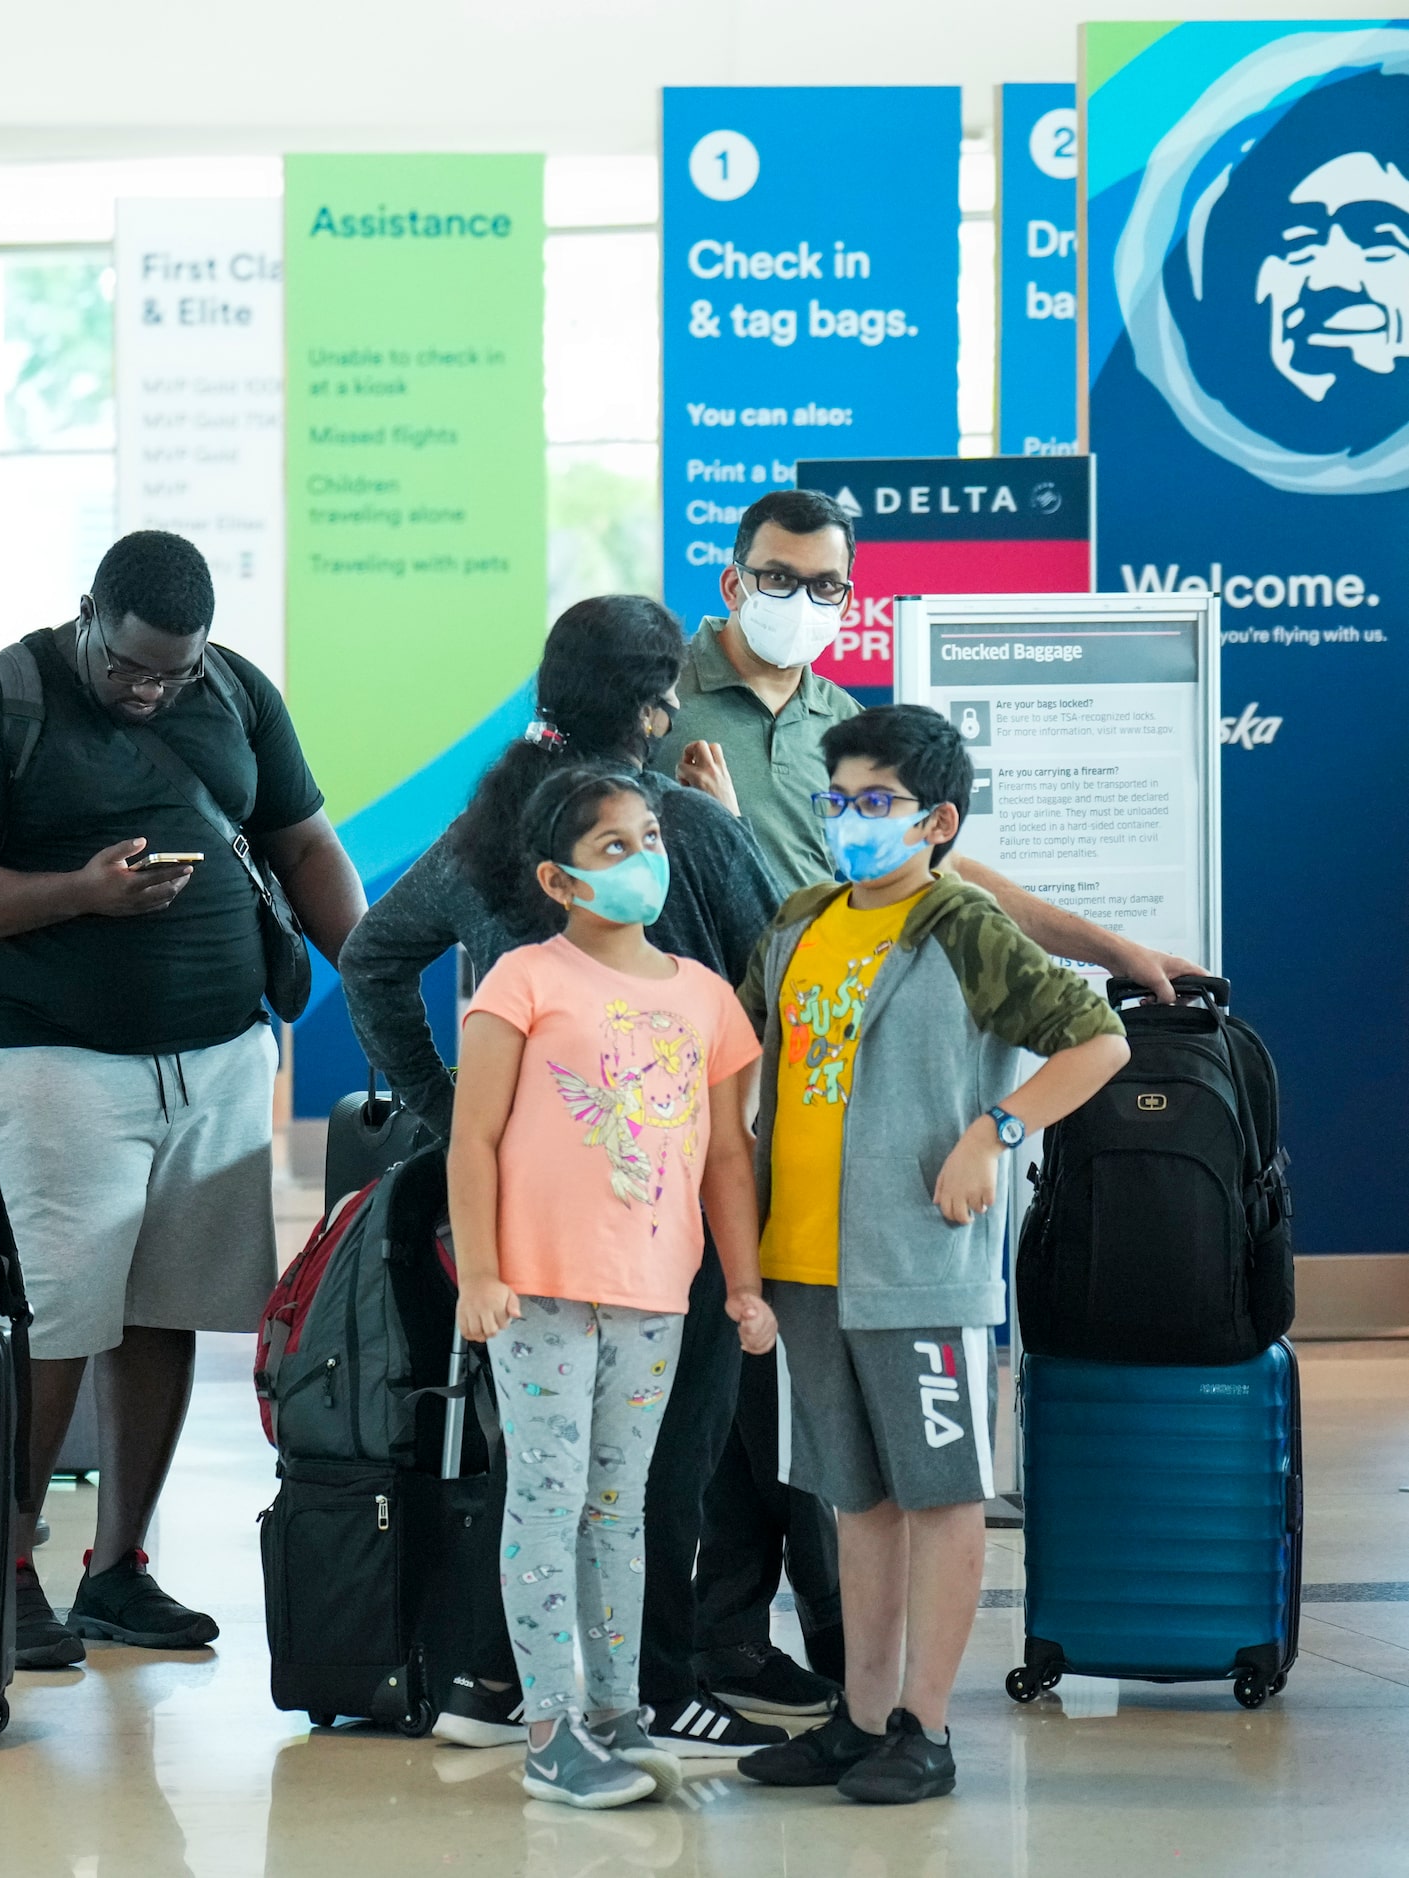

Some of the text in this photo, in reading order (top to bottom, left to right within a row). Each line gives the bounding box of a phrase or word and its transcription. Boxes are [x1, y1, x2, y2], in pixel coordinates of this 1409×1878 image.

[1054, 127, 1077, 157] 2
[714, 151, 729, 180] 1
[310, 205, 512, 239] Assistance
[142, 252, 216, 282] First
[688, 240, 870, 279] Check in
[142, 298, 253, 326] & Elite
[688, 300, 919, 347] & tag bags.
[308, 347, 383, 368] Unable
[390, 350, 412, 368] to
[417, 347, 477, 368] check
[354, 376, 408, 396] kiosk
[687, 403, 853, 427] You can also:
[309, 425, 459, 450] Missed flights
[687, 459, 745, 483] Print
[751, 464, 767, 483] a
[307, 474, 400, 495] Children
[876, 485, 1018, 514] DELTA
[308, 506, 465, 528] traveling alone
[310, 555, 510, 577] Traveling with pets
[1273, 625, 1319, 646] flying
[1324, 625, 1360, 642] with
[1364, 630, 1388, 642] us.
[941, 643, 1083, 662] Checked Baggage
[996, 698, 1094, 711] Are your bags locked?
[998, 766, 1119, 779] Are you carrying a firearm?
[1038, 882, 1075, 893] carrying
[1077, 882, 1100, 891] film?
[1059, 896, 1105, 906] equipment
[1108, 896, 1127, 905] may
[1130, 894, 1164, 904] damage
[1083, 909, 1112, 918] Please
[1114, 909, 1148, 918] remove
[1151, 908, 1157, 916] it
[800, 976, 865, 1041] JUST
[788, 1023, 829, 1068] DO
[803, 1061, 844, 1104] IT
[913, 1341, 965, 1449] FILA
